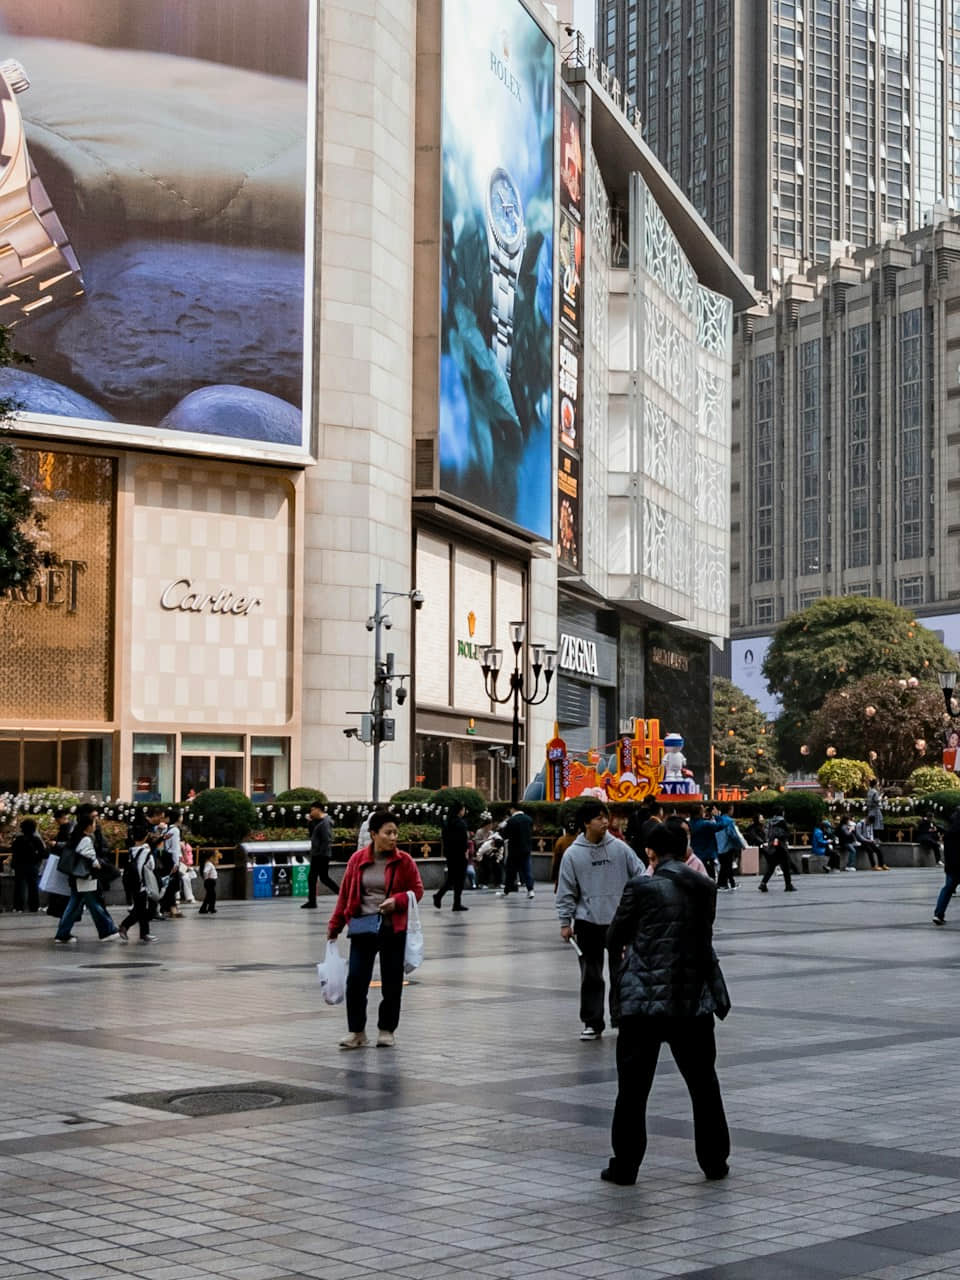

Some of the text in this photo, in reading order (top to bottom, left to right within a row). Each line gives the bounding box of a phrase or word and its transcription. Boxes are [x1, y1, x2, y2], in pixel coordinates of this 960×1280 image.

[490, 51, 522, 103] ROLEX
[160, 578, 263, 616] Cartier
[560, 634, 599, 677] ZEGNA
